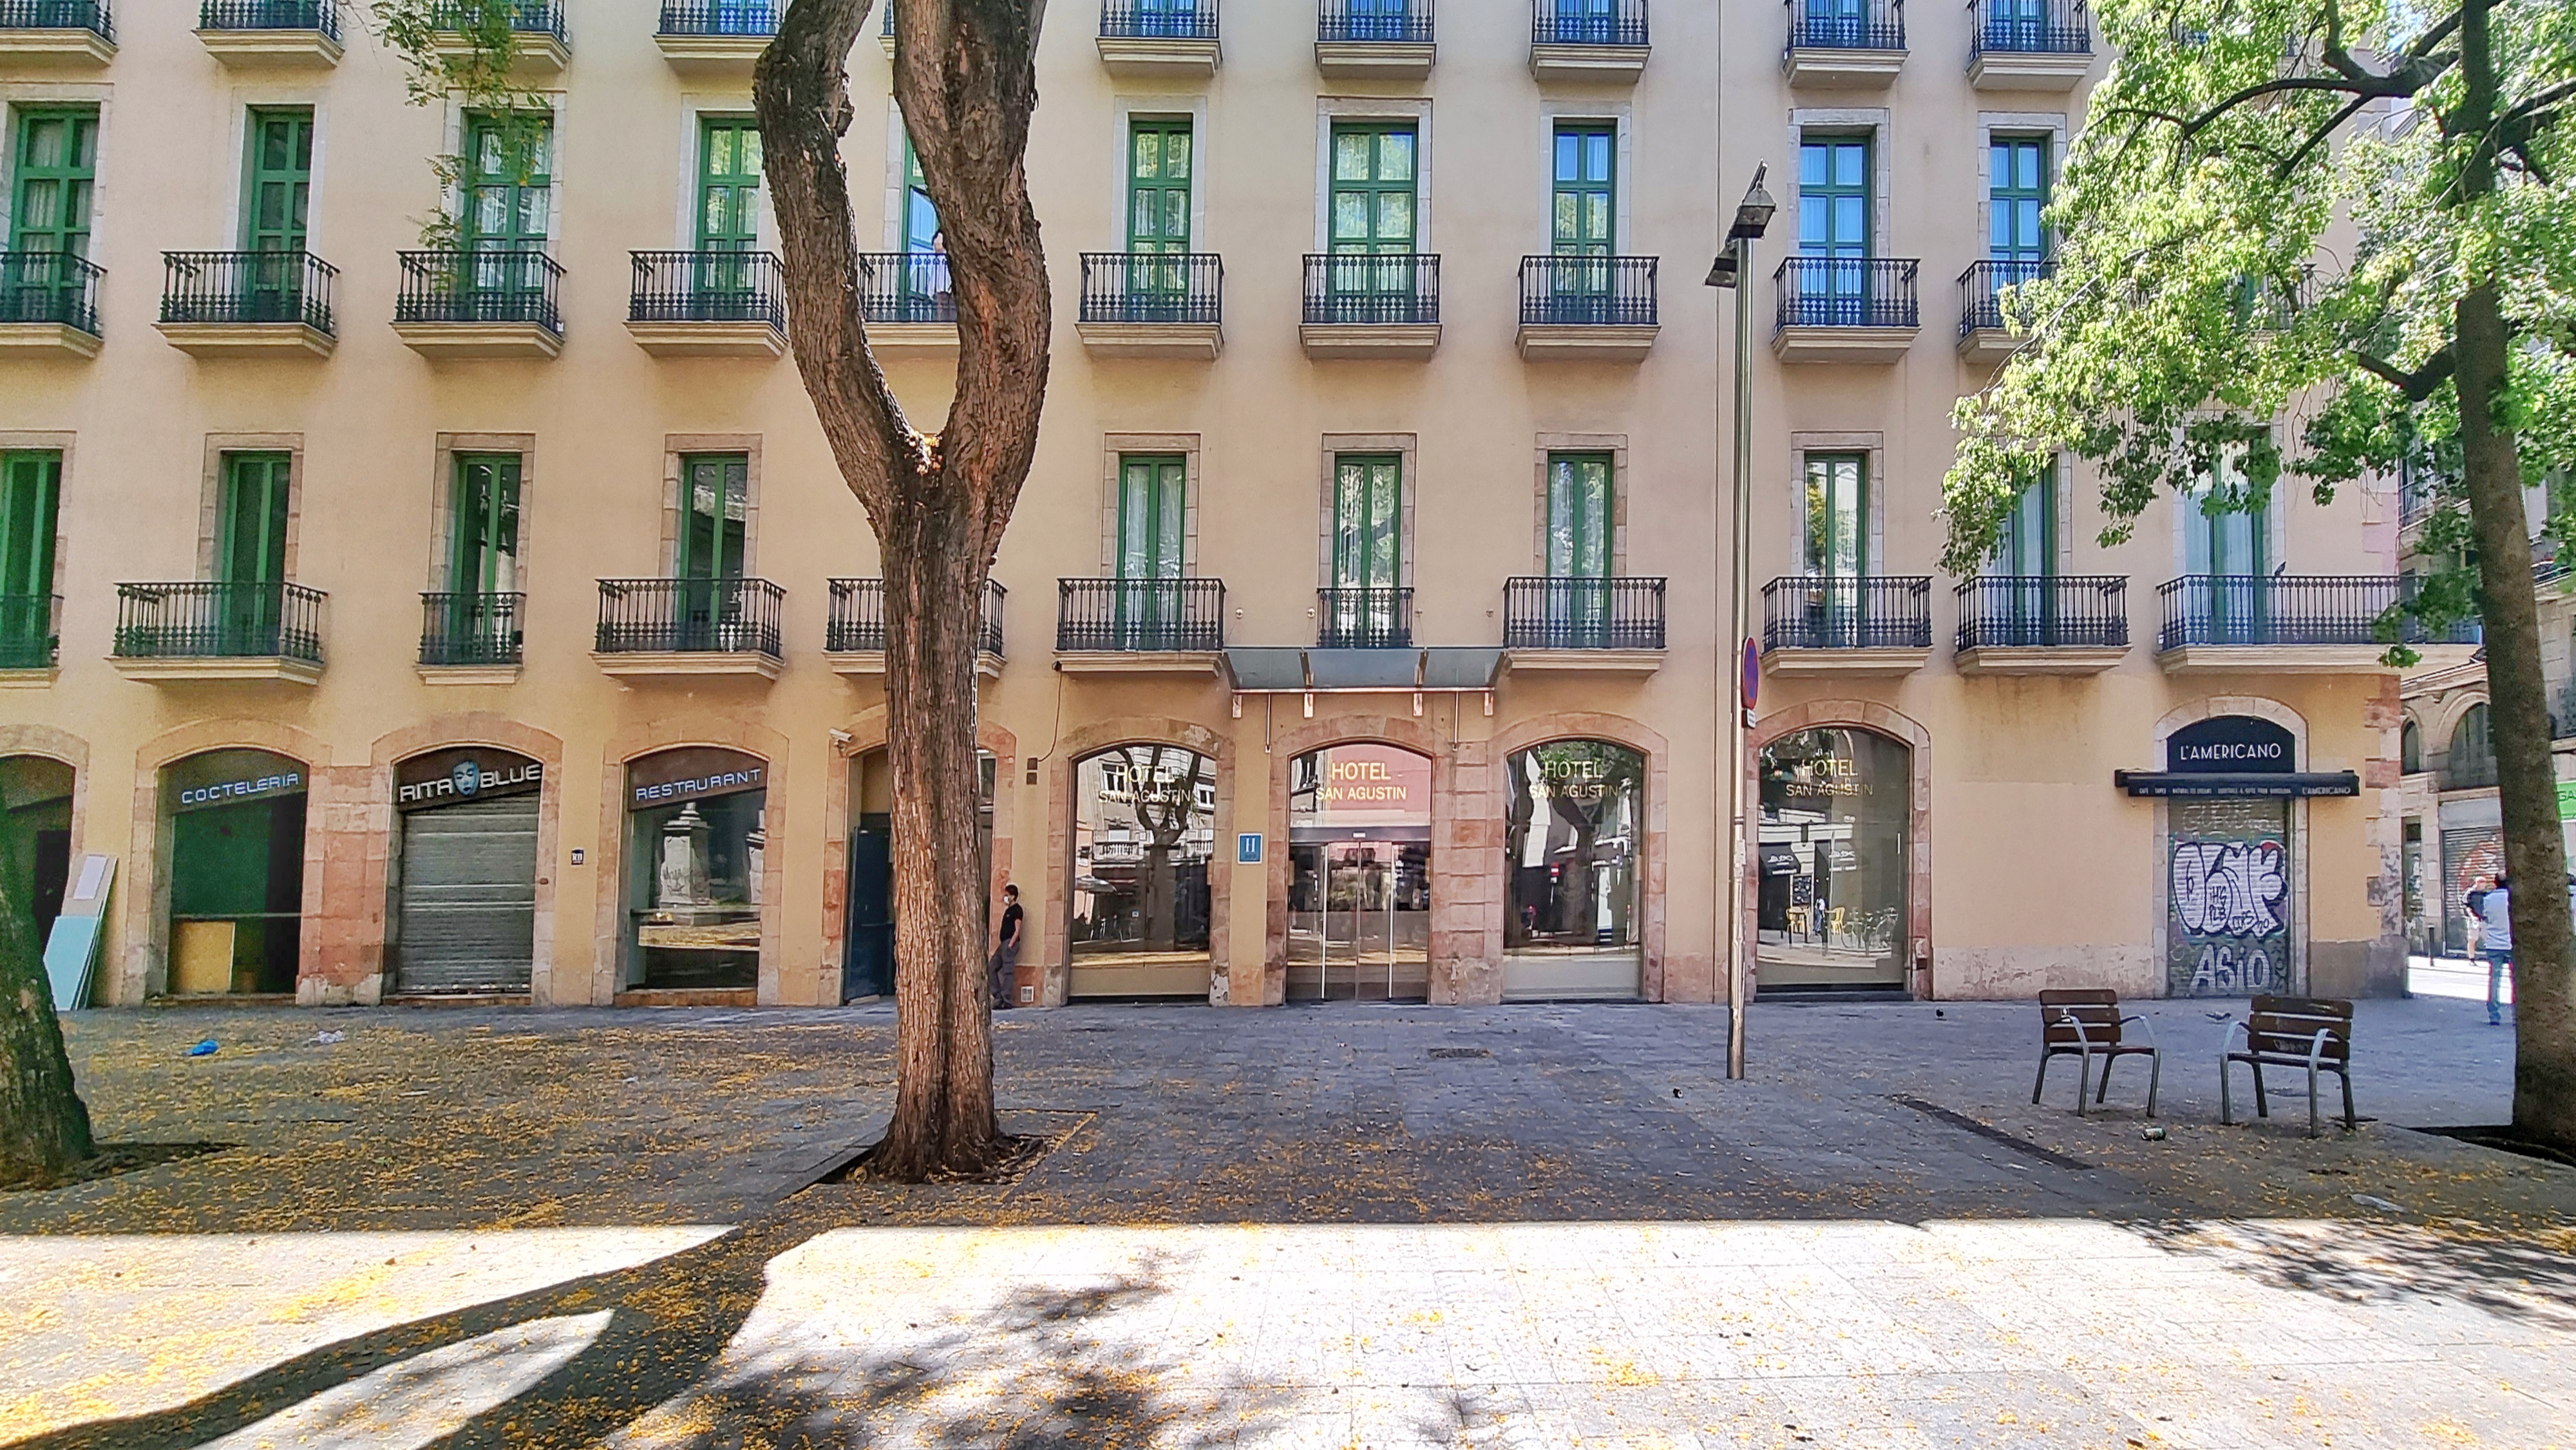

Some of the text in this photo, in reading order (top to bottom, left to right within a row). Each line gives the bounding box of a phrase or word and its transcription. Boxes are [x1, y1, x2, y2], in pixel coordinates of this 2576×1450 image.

[2180, 742, 2282, 760] L'AMERICANO
[1115, 765, 1175, 783] HOTEL
[1332, 762, 1392, 780] HOTEL
[1545, 760, 1604, 778] HOTEL
[1802, 759, 1859, 777] HOTEL
[399, 764, 542, 802] RITA BLUE
[635, 768, 761, 801] RESTAURANT
[1529, 784, 1618, 798] SAN AGUSTIN
[1786, 783, 1873, 797] SAN AGUSTIN
[1098, 789, 1191, 803] SAN AGUSTIN
[1315, 786, 1406, 800] SAN AGUSTIN
